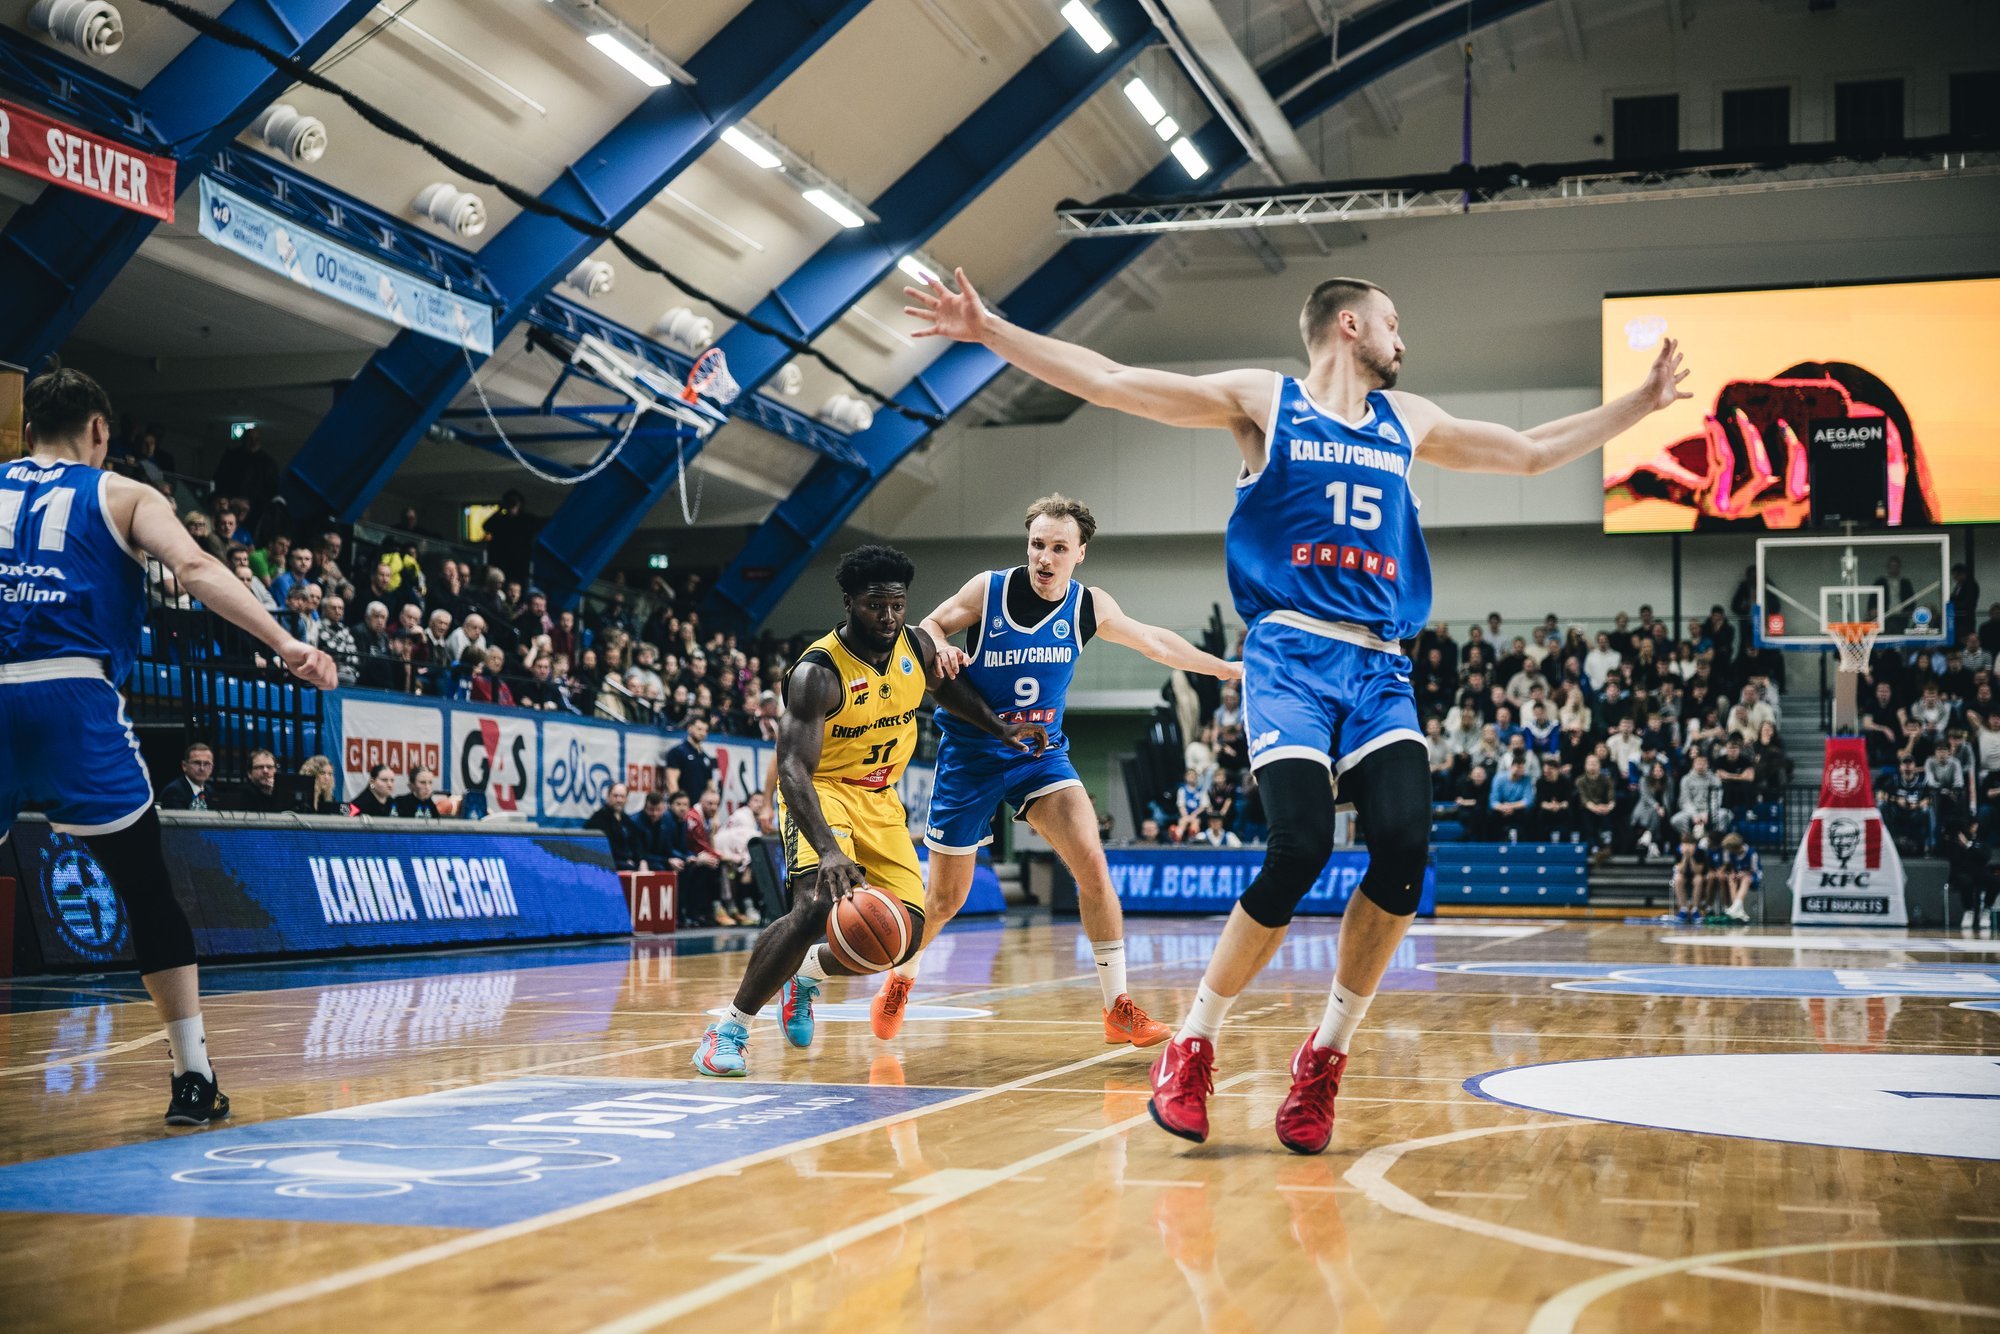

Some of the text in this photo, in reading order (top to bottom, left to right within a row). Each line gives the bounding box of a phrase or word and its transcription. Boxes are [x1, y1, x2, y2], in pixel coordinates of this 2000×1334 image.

[47, 127, 149, 208] SELVER
[1814, 427, 1882, 443] AEGAON
[1290, 439, 1405, 478] KALEV/CRAMO
[1325, 481, 1383, 531] 15
[1296, 547, 1396, 577] CRAMO
[983, 646, 1072, 668] KALEV/CRAMO
[1014, 677, 1040, 707] 9
[350, 743, 438, 771] CRAMO
[461, 718, 527, 811] G4S
[308, 857, 519, 925] KANNA MERCHI
[1819, 872, 1871, 889] KFC
[1806, 897, 1883, 914] GET BUCKETS
[694, 1096, 856, 1131] PESULAD
